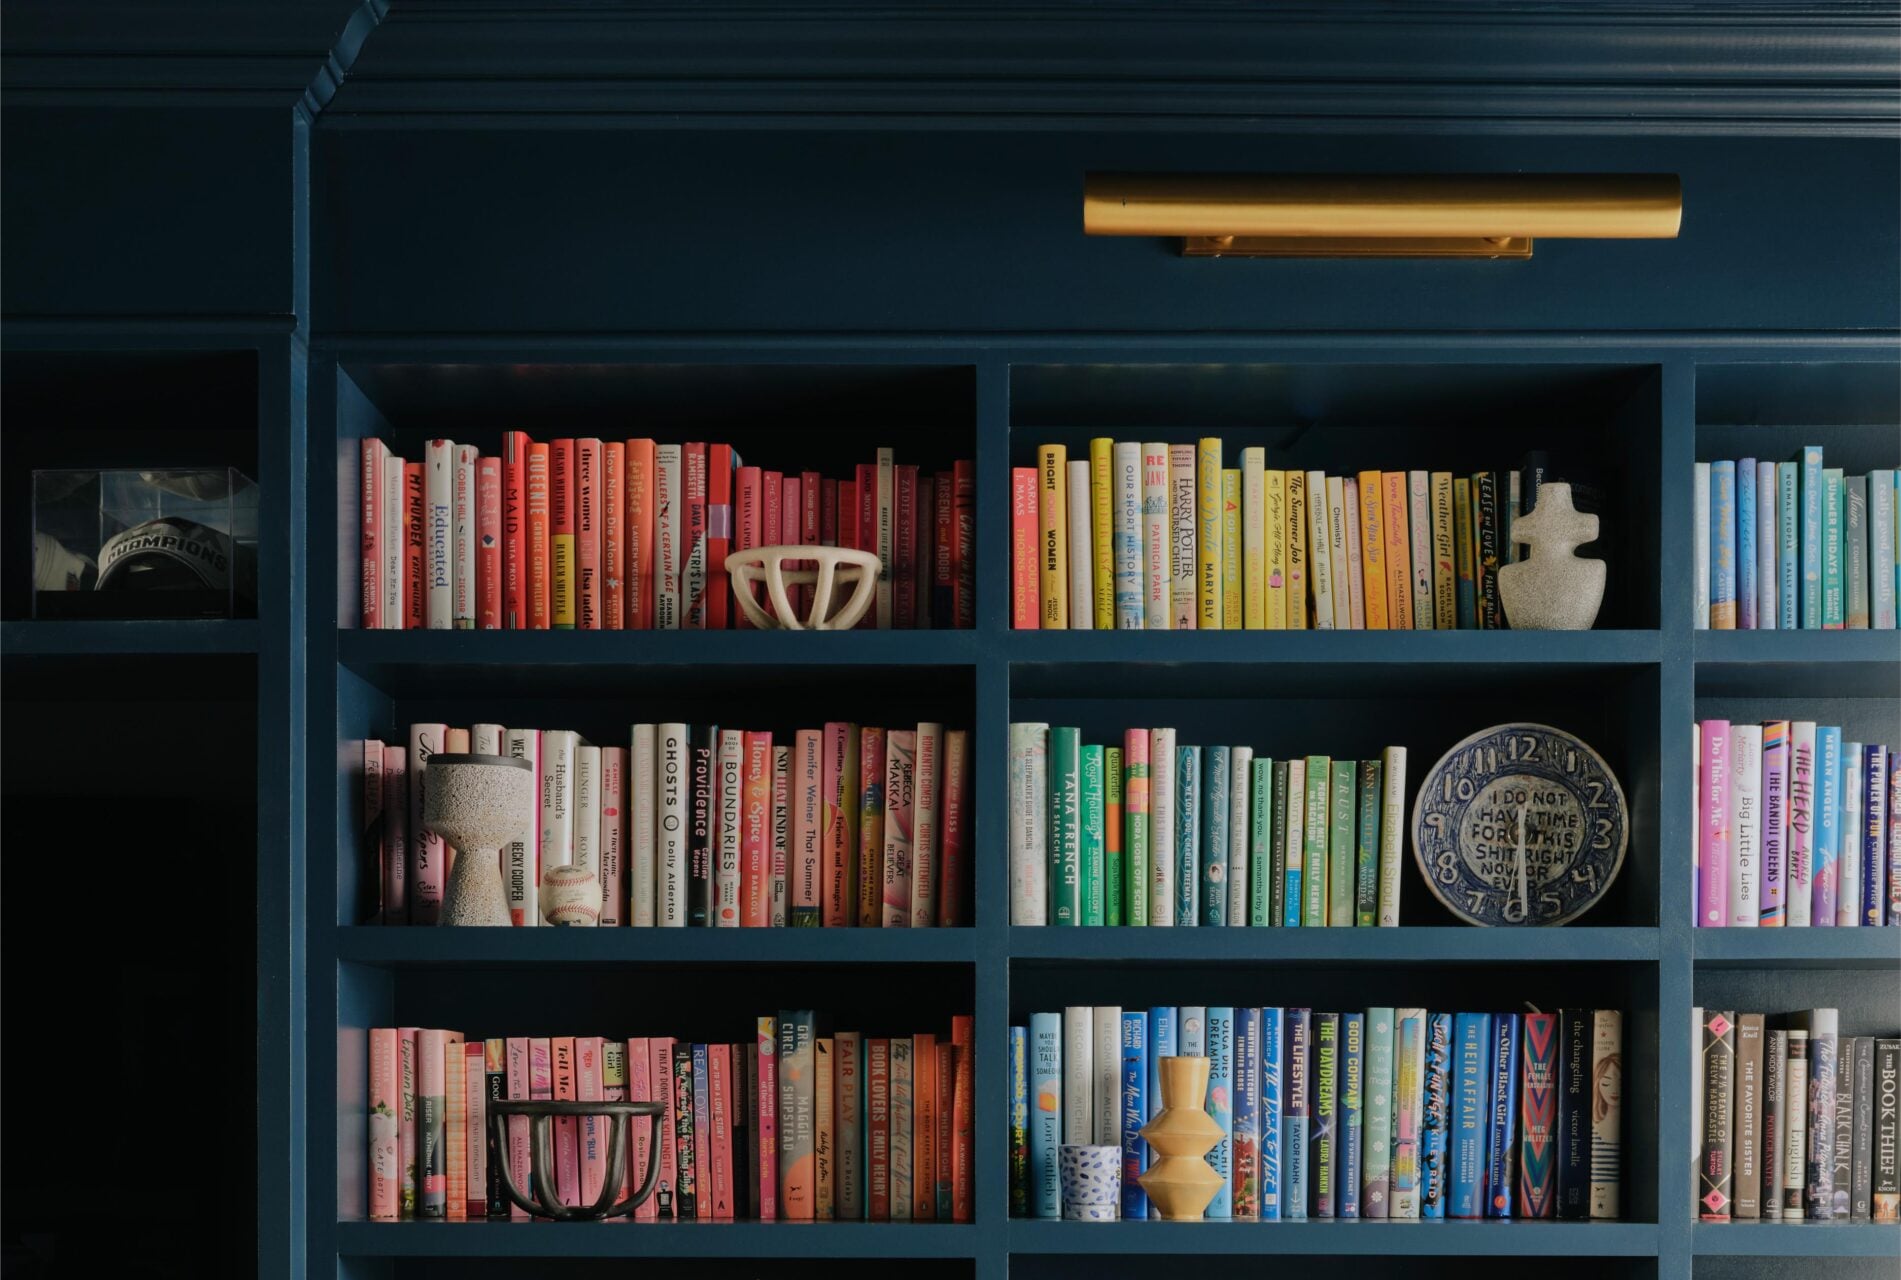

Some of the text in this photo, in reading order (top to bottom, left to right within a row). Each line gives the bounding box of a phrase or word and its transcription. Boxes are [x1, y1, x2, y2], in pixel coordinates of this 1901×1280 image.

[506, 488, 518, 534] MAID
[607, 449, 616, 572] How Not to Die Alone
[1126, 465, 1135, 585] OUR SHORT HISTORY
[1179, 478, 1194, 580] HARRY POTTER
[1289, 476, 1303, 564] The Summer Job
[1333, 507, 1342, 549] Chemistry
[1437, 479, 1454, 557] Weather Girl
[1827, 477, 1838, 575] SUMMER FRIDAYS
[108, 535, 228, 572] CHAMPIONS
[435, 505, 449, 587] Educated
[556, 543, 566, 615] HARLEM SHUFFLE
[1205, 563, 1214, 619] MARY BLY
[1475, 747, 1497, 775] 11
[1509, 736, 1540, 763] 12
[1566, 749, 1577, 773] 1
[544, 775, 553, 808] Secret
[695, 748, 710, 837] Providence
[888, 759, 900, 811] MAKKAI
[902, 763, 912, 807] REBECCA
[1085, 753, 1101, 836] Royal Holiday
[1443, 772, 1475, 803] 10
[1493, 791, 1567, 805] I DO NOT
[1587, 781, 1609, 808] 2
[1711, 736, 1723, 825] Do This for Me
[1793, 747, 1812, 834] THE HERD
[666, 738, 677, 920] GHOSTS Dolly Alderton
[723, 761, 737, 870] BOUNDARIES
[804, 736, 818, 901] Jennifer Weiner That Summer
[918, 735, 934, 899] ROMANTIC COMEDY CURTIS SITTENFELD
[1065, 771, 1075, 885] TANA FRENCH
[1425, 812, 1444, 839] 9
[1472, 824, 1574, 848] FOR THIS
[1481, 808, 1578, 828] HAVE TIME
[1593, 819, 1614, 849] 3
[1767, 771, 1782, 883] THE BANDIT QUEENS
[511, 841, 524, 902] BECKY COOPER
[896, 849, 905, 877] GREAT
[1383, 804, 1400, 908] Elizabeth Strout
[1437, 851, 1459, 884] 8
[1476, 844, 1575, 864] SHIT RIGHT
[1522, 866, 1549, 880] OR
[1571, 865, 1596, 893] 4
[1739, 797, 1753, 901] Big Little Lies
[1467, 891, 1486, 914] 7
[1493, 877, 1537, 891] EVR
[1505, 898, 1524, 923] 6
[1540, 892, 1561, 916] 5
[1158, 1017, 1168, 1038] Elin
[1210, 1018, 1220, 1080] DREAMING
[1463, 1042, 1477, 1074] HEIR
[402, 1038, 414, 1122] Expiration Dates
[558, 1046, 570, 1094] Tell Me
[694, 1049, 706, 1123] REAL LOVE
[842, 1040, 854, 1124] FAIR PLAY
[1347, 1021, 1360, 1111] GOOD COMPANY
[1496, 1024, 1511, 1125] The Other Black Girl
[1569, 1020, 1583, 1167] the changeling victor lavalle
[1881, 1069, 1896, 1124] BOOK
[797, 1096, 809, 1141] MAGGIE
[872, 1045, 885, 1197] BOOK LOVERS EMILY HENRY
[1292, 1023, 1304, 1184] THE LIFESTYLE TAYLOR HAHN
[1318, 1021, 1335, 1194] THE DAYDREAMS LAURA HANKIN
[1462, 1079, 1476, 1129] AFFAIR
[1744, 1061, 1753, 1176] THE FAVORITE SISTER
[1788, 1067, 1805, 1180] Dreyer's English
[1834, 1092, 1851, 1173] BLACK CHALK
[1045, 1117, 1057, 1197] Lori Gottlieb
[1880, 1127, 1895, 1175] THIEF
